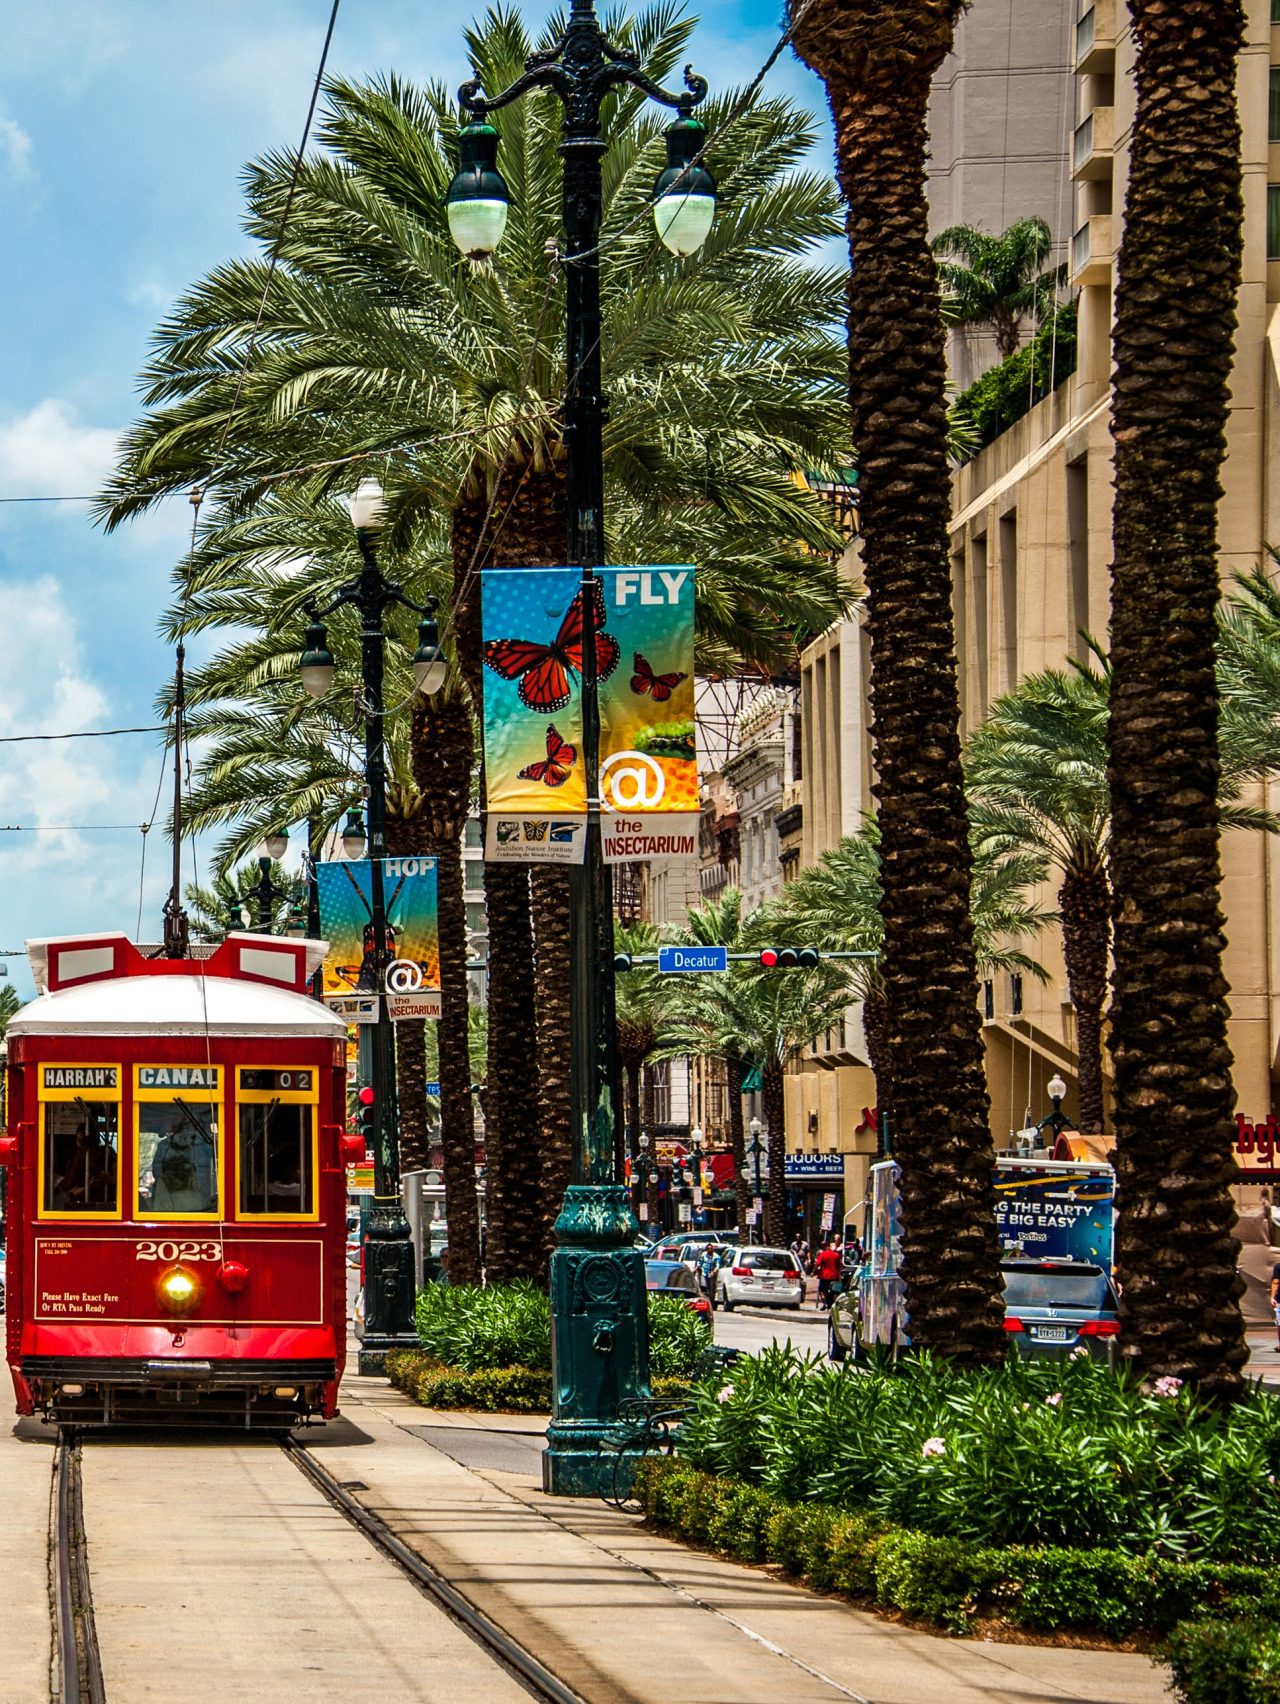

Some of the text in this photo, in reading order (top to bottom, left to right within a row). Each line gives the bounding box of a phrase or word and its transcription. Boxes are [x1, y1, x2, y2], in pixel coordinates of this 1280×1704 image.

[615, 571, 689, 605] FLY
[615, 819, 642, 832] the
[604, 836, 694, 857] INSECTARIUM
[385, 859, 435, 877] HOP
[674, 952, 719, 967] Decatur
[394, 997, 410, 1005] the
[389, 1004, 440, 1018] INSECTARIUM
[45, 1069, 117, 1087] HARRAH'S
[140, 1068, 217, 1086] CANAL
[784, 1154, 842, 1165] LIQUORS
[1012, 1202, 1041, 1214] THE
[1044, 1204, 1093, 1217] PARTY
[1009, 1214, 1034, 1226] BIG
[1038, 1216, 1077, 1228] EASY
[136, 1241, 222, 1262] 2023
[42, 1292, 119, 1302] Please Have Exact Fare
[42, 1303, 106, 1314] Or RTA Pass Ready
